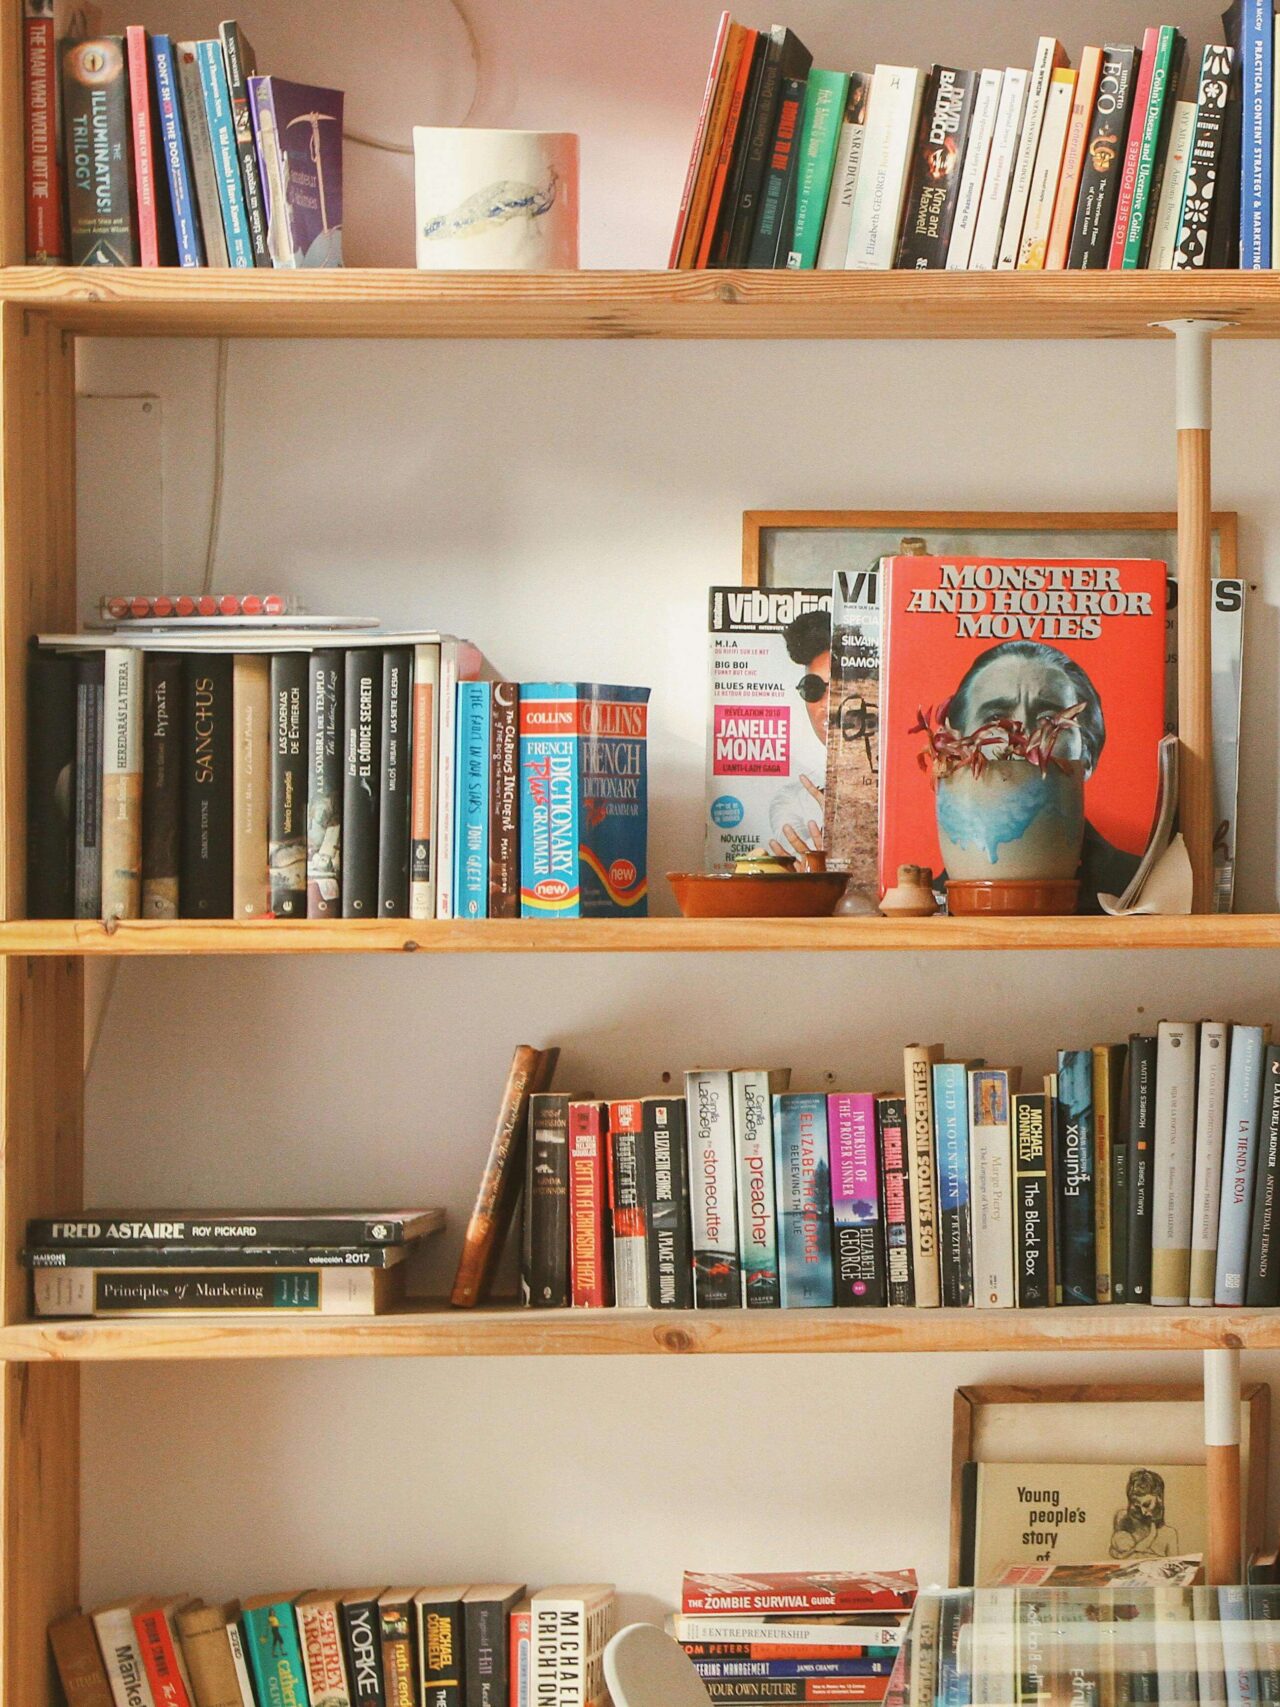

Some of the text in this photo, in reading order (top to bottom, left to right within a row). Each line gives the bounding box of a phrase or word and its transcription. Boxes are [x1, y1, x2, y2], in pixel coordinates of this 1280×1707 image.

[31, 25, 46, 45] THE
[31, 47, 46, 76] MAN
[157, 54, 169, 85] DON'T
[1254, 40, 1263, 95] PRACTICAL
[31, 80, 47, 109] WHO
[928, 70, 954, 145] BALDACCI
[946, 88, 965, 132] DAVID
[1096, 61, 1122, 115] ECO
[1116, 69, 1128, 109] umberto
[32, 111, 48, 154] WOULD
[166, 122, 175, 139] THE
[1253, 98, 1263, 145] CONTENT
[33, 155, 48, 178] NOT
[73, 115, 90, 191] TRILOGY
[91, 91, 111, 213] ILLUMINATUS!
[113, 143, 121, 160] THE
[167, 141, 180, 168] DOG!
[841, 129, 863, 207] SARAH DUNANT
[1128, 69, 1165, 243] Crohn's Disease and Ulcerative Colitis
[1252, 148, 1262, 198] STRATEGY
[33, 181, 49, 198] DIE
[915, 186, 934, 234] Maxwell
[926, 187, 946, 238] King and
[1252, 211, 1261, 269] MARKETING
[938, 564, 1120, 592] MONSTER
[906, 590, 1153, 615] AND HORROR
[715, 640, 738, 648] M.I.A
[955, 615, 1102, 639] MOVIES
[746, 683, 785, 691] REVIVAL
[117, 662, 129, 768] HEREDARÁS LA TIERRA
[195, 677, 215, 783] SANCTUS
[359, 678, 373, 776] EL CÓDICE SECRETO
[526, 712, 573, 724] COLLINS
[716, 719, 787, 739] JANELLE
[527, 741, 573, 755] FRENCH
[716, 740, 787, 763] MONAE
[522, 757, 550, 875] Plus GRAMMAR
[549, 757, 573, 876] DICTIONARY
[466, 823, 482, 891] JOHN GREEN
[536, 886, 568, 895] new
[838, 1099, 854, 1196] THE PROPER SINNER
[852, 1111, 867, 1183] IN PURSUIT OF
[1018, 1104, 1031, 1162] CONNELLY
[1030, 1109, 1043, 1159] MICHAEL
[1064, 1124, 1090, 1196] Equinox
[1233, 1119, 1249, 1204] LA TIENDA ROJA
[703, 1149, 721, 1243] stonecutter
[743, 1156, 770, 1247] preacher
[800, 1113, 819, 1264] ELIZABETH GEORGE
[52, 1222, 257, 1239] FRED ASTAIRE ROY PICKARD
[1024, 1182, 1041, 1276] The Black Box
[345, 1253, 370, 1263] 2017
[889, 1247, 908, 1283] CONGO
[104, 1284, 169, 1298] Principles
[175, 1284, 189, 1299] of
[195, 1283, 264, 1298] Marketing
[1017, 1486, 1060, 1507] Young
[1029, 1506, 1086, 1527] people's
[1022, 1531, 1058, 1548] story
[688, 1595, 836, 1609] THE ZOMBIE SURVIVAL GUIDE
[350, 1611, 379, 1697] YORKE
[427, 1614, 441, 1671] CONNELLY
[439, 1617, 452, 1668] MICHAEL
[708, 1629, 810, 1639] ENTREPRENEURSHIP
[708, 1682, 797, 1696] YOUR OWN FUTURE
